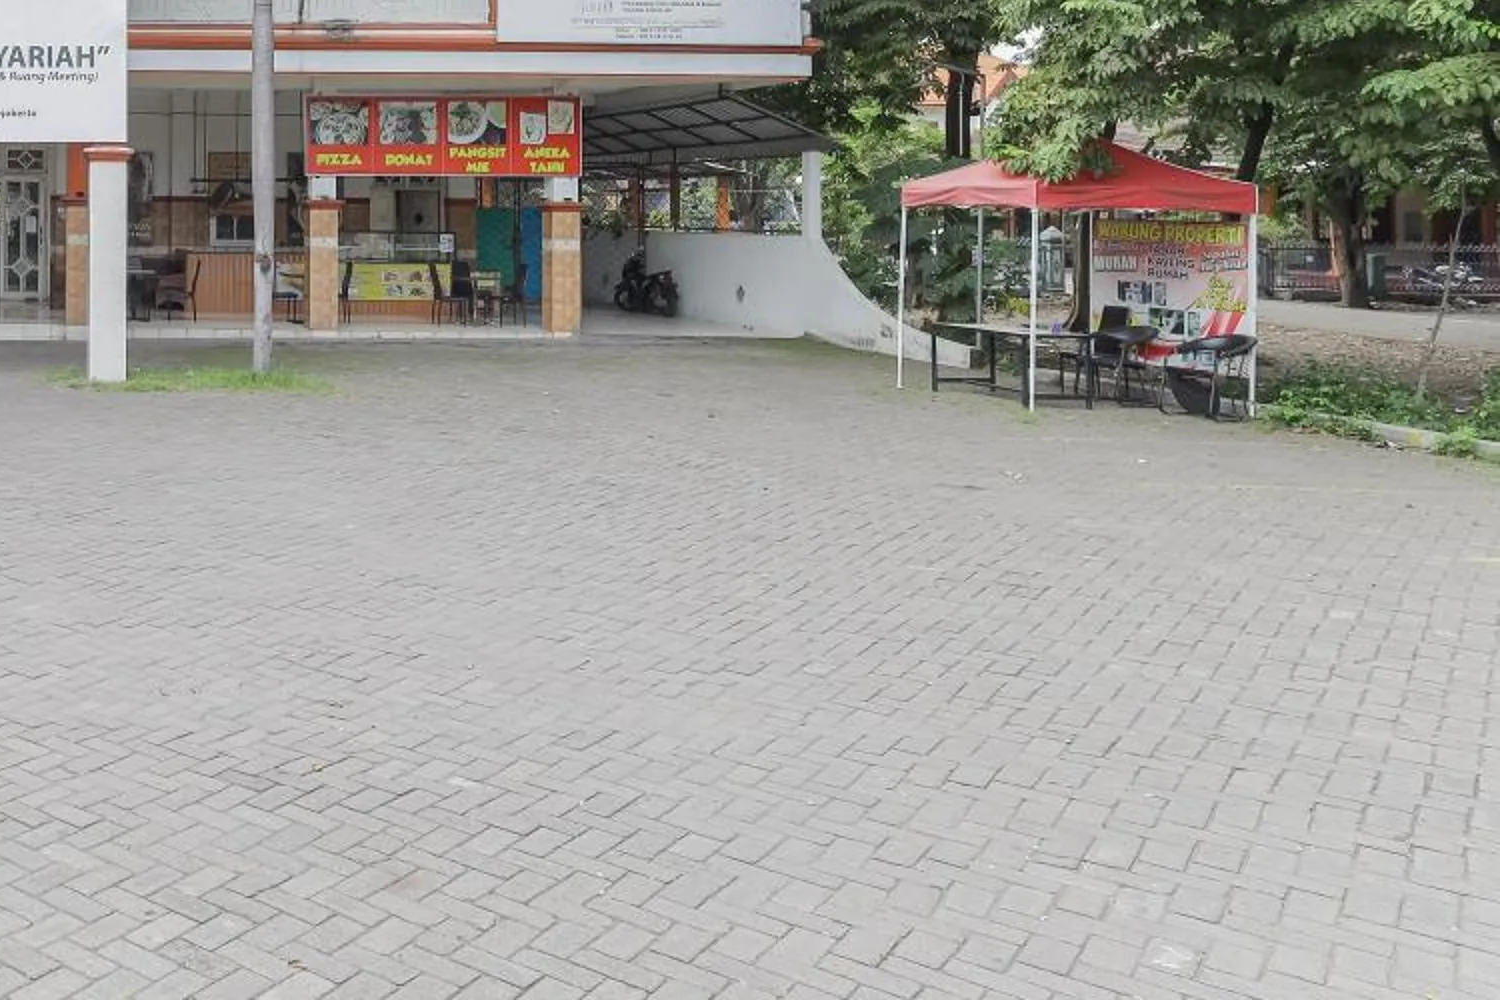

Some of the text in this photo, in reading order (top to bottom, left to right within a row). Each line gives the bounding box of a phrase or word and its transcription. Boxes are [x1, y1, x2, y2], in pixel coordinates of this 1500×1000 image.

[0, 71, 7, 82] &
[9, 71, 45, 84] Ruang
[48, 71, 99, 84] Meeting)
[316, 152, 362, 166] PIZZA
[384, 152, 434, 166] DONAT
[449, 147, 506, 160] PANGSIT
[1164, 225, 1245, 246] PROPERTI
[1147, 267, 1189, 280] RUMAH
